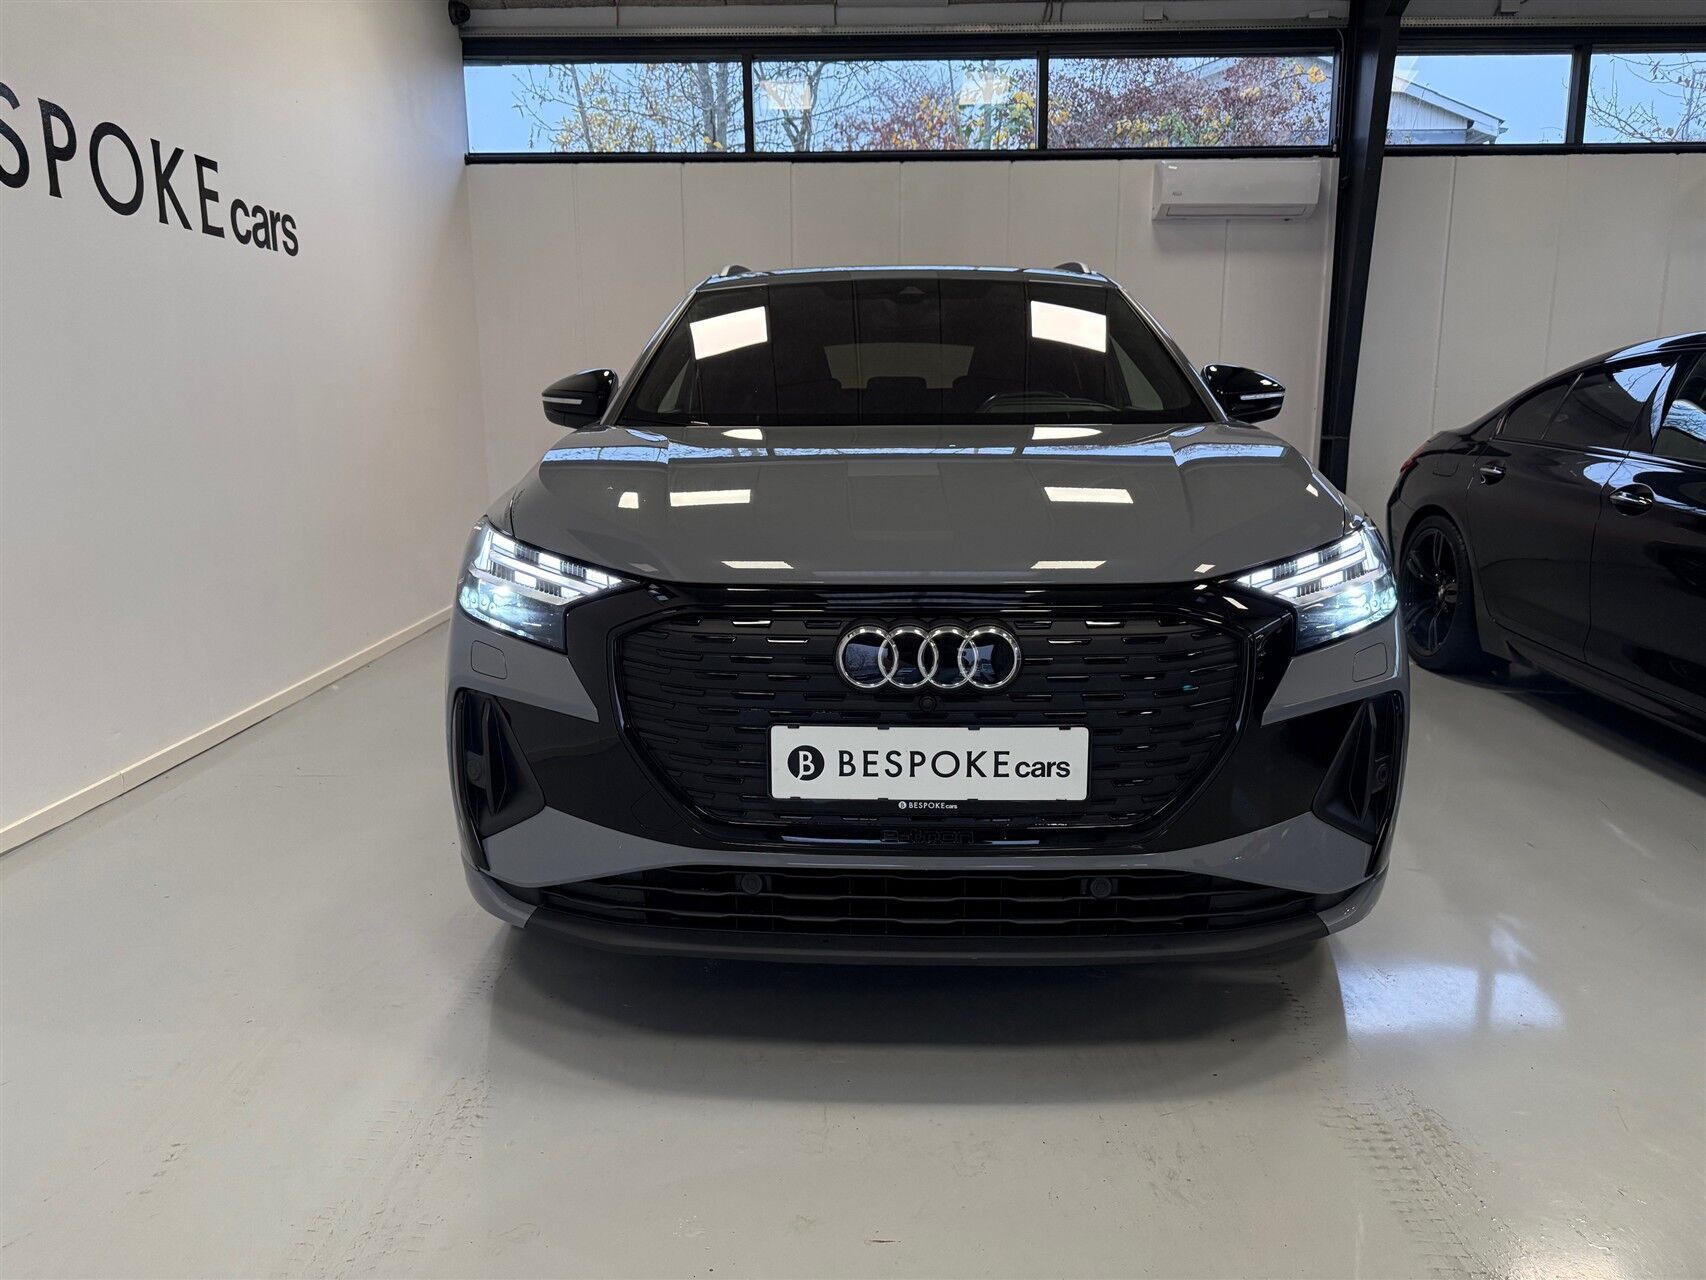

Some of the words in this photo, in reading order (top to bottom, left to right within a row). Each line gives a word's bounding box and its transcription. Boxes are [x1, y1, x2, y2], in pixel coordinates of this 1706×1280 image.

[230, 198, 299, 257] cars
[838, 750, 1010, 778] BESPOKE
[1014, 760, 1071, 778] cars
[908, 801, 945, 809] BESPOKE
